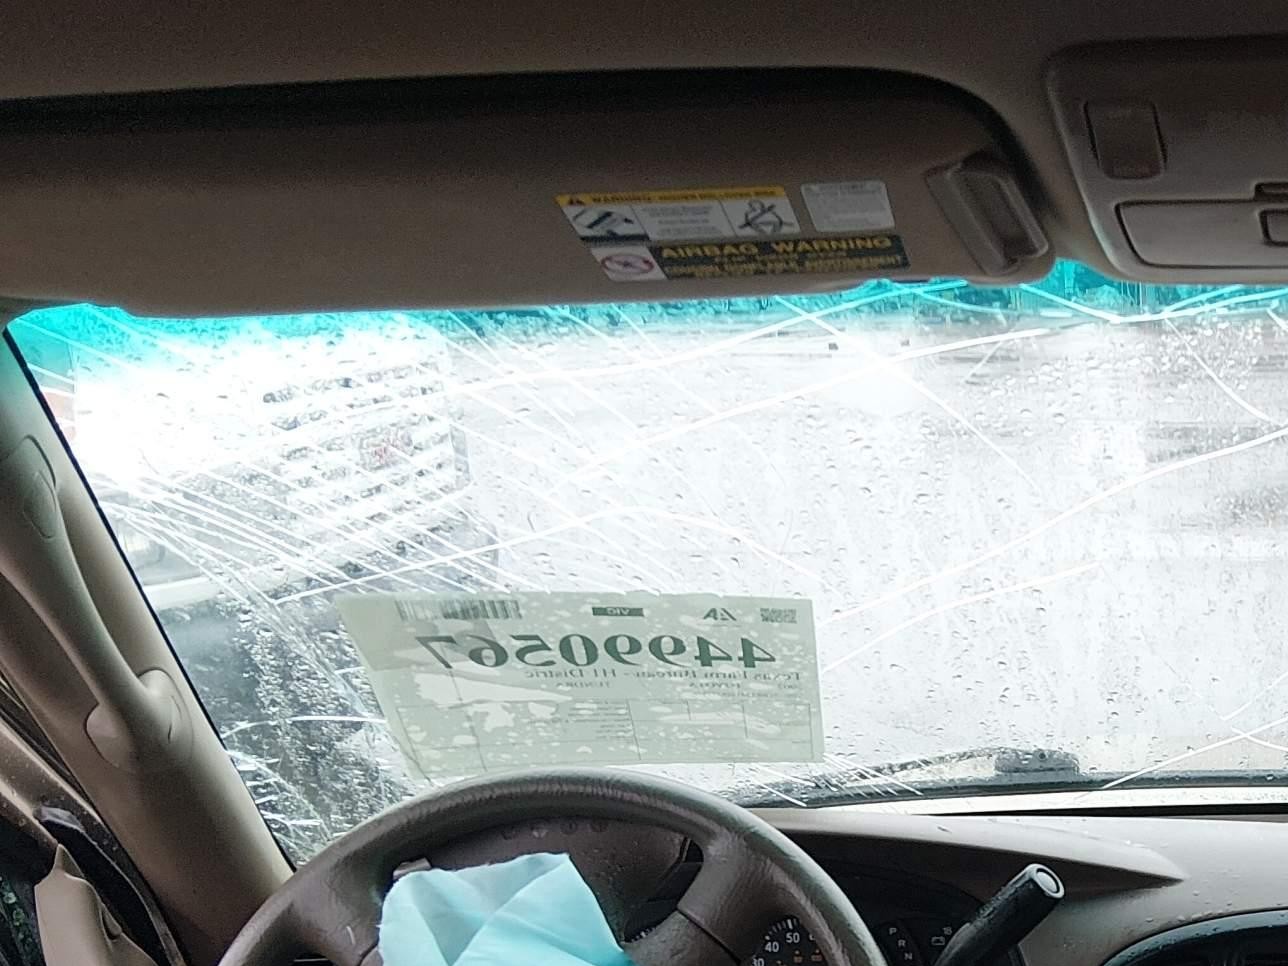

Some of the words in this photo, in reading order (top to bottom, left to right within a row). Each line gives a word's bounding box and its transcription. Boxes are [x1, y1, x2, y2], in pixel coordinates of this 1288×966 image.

[662, 244, 759, 258] AIRBAG
[771, 237, 892, 253] WARNING
[786, 932, 800, 944] 50
[764, 941, 779, 953] 40
